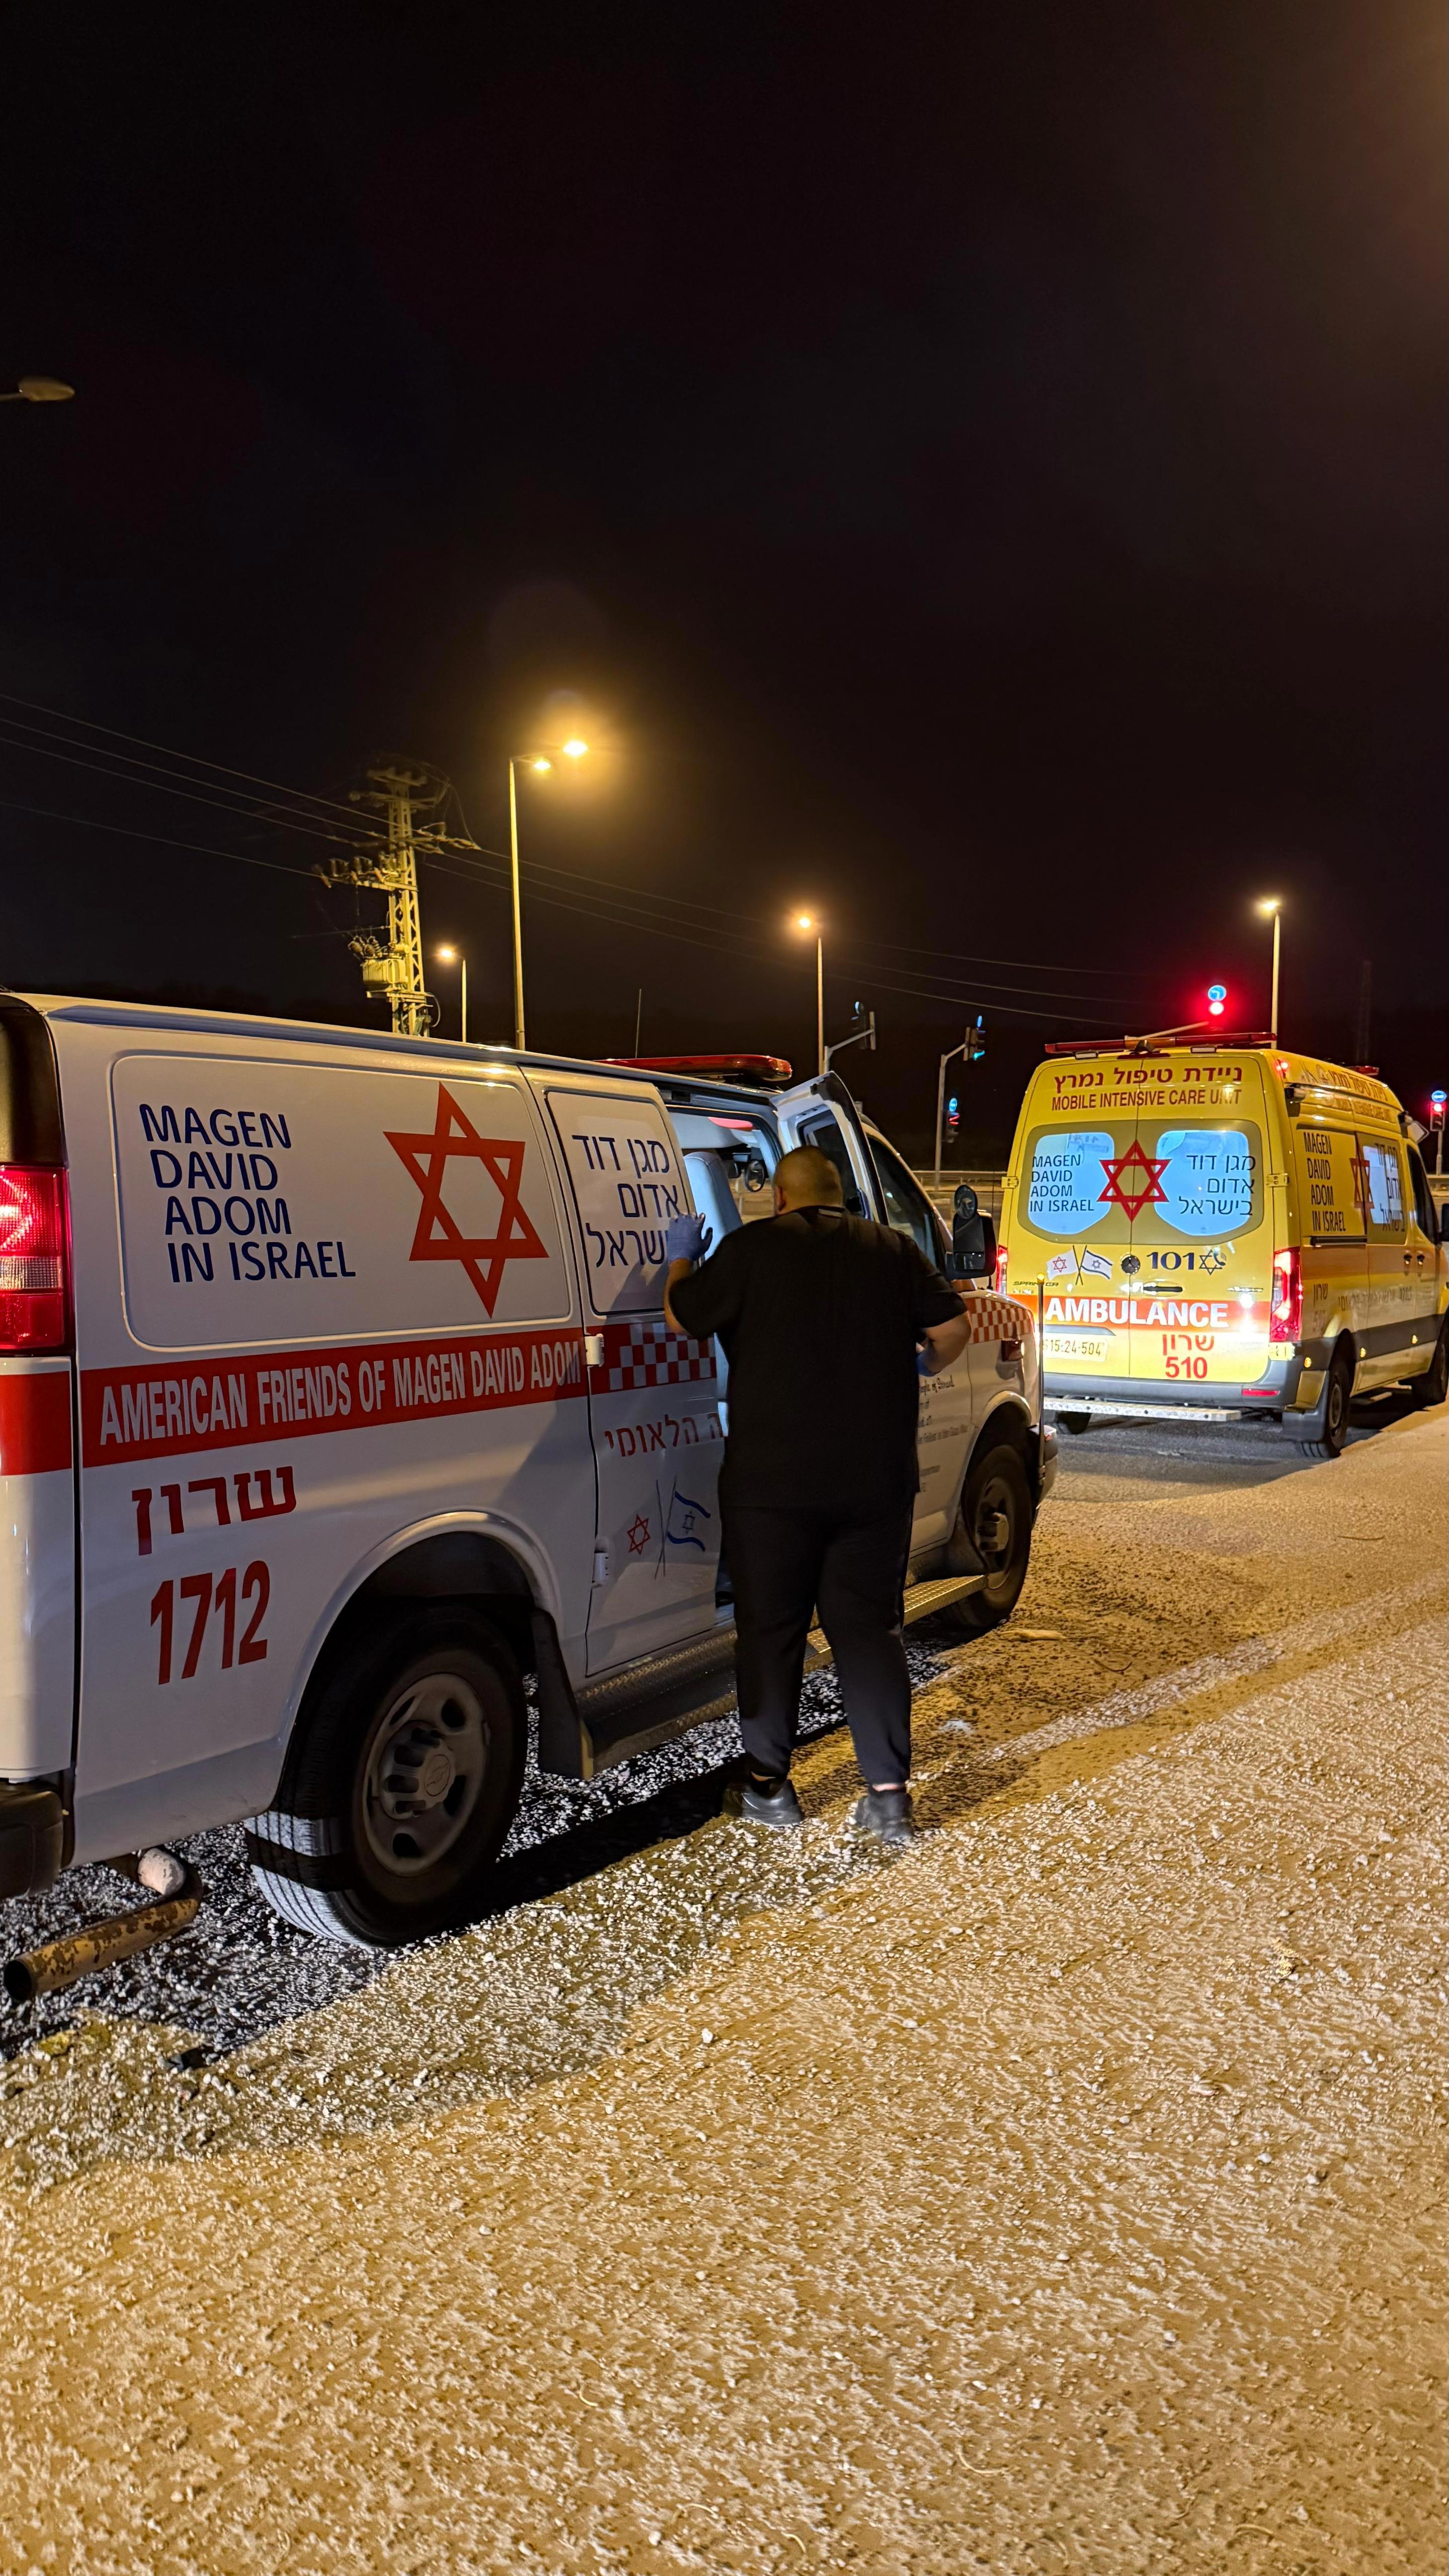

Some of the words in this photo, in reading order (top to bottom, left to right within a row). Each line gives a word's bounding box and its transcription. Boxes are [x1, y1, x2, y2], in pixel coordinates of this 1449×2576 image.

[1054, 1072, 1104, 1094] נמרץ
[1113, 1067, 1173, 1085] טיפול
[1183, 1067, 1242, 1082] ניידת
[1052, 1093, 1096, 1111] MOBILE
[1099, 1090, 1165, 1108] INTENSIVE
[1168, 1089, 1205, 1105] CARE
[139, 1103, 291, 1149] MAGEN
[572, 1135, 620, 1171] דוד
[1304, 1132, 1332, 1155] MAGEN
[150, 1149, 278, 1190] DAVID
[627, 1139, 669, 1179] מגן
[1032, 1155, 1081, 1168] MAGEN
[1186, 1155, 1216, 1171] דוד
[1225, 1155, 1256, 1173] מגן
[1307, 1158, 1331, 1180] DAVID
[1031, 1170, 1073, 1182] DAVID
[1208, 1178, 1254, 1194] אדום
[617, 1184, 681, 1218] אדום
[1031, 1185, 1073, 1197] ADOM
[1311, 1184, 1334, 1205] ADOM
[165, 1195, 292, 1235] ADOM
[1030, 1200, 1046, 1212] IN
[1049, 1199, 1094, 1212] ISRAEL
[1179, 1196, 1253, 1216] בישראל
[1312, 1211, 1321, 1231] IN
[1323, 1211, 1346, 1232] ISRAEL
[168, 1242, 214, 1282] IN
[229, 1241, 356, 1281] ISRAEL
[1146, 1252, 1194, 1270] 101
[1313, 1283, 1328, 1307] שרון
[1045, 1298, 1230, 1328] AMBULANCE
[1162, 1334, 1215, 1355] שרון
[1165, 1357, 1208, 1379] 510
[100, 1374, 248, 1445] AMERICAN
[257, 1362, 351, 1425] FRIENDS
[358, 1360, 385, 1412] OF
[392, 1352, 466, 1407] MAGEN
[470, 1347, 525, 1397] DAVID
[531, 1341, 581, 1390] ADOM
[604, 1414, 699, 1457] הלאומי
[132, 1466, 297, 1556] שרון
[150, 1560, 270, 1685] 1712
